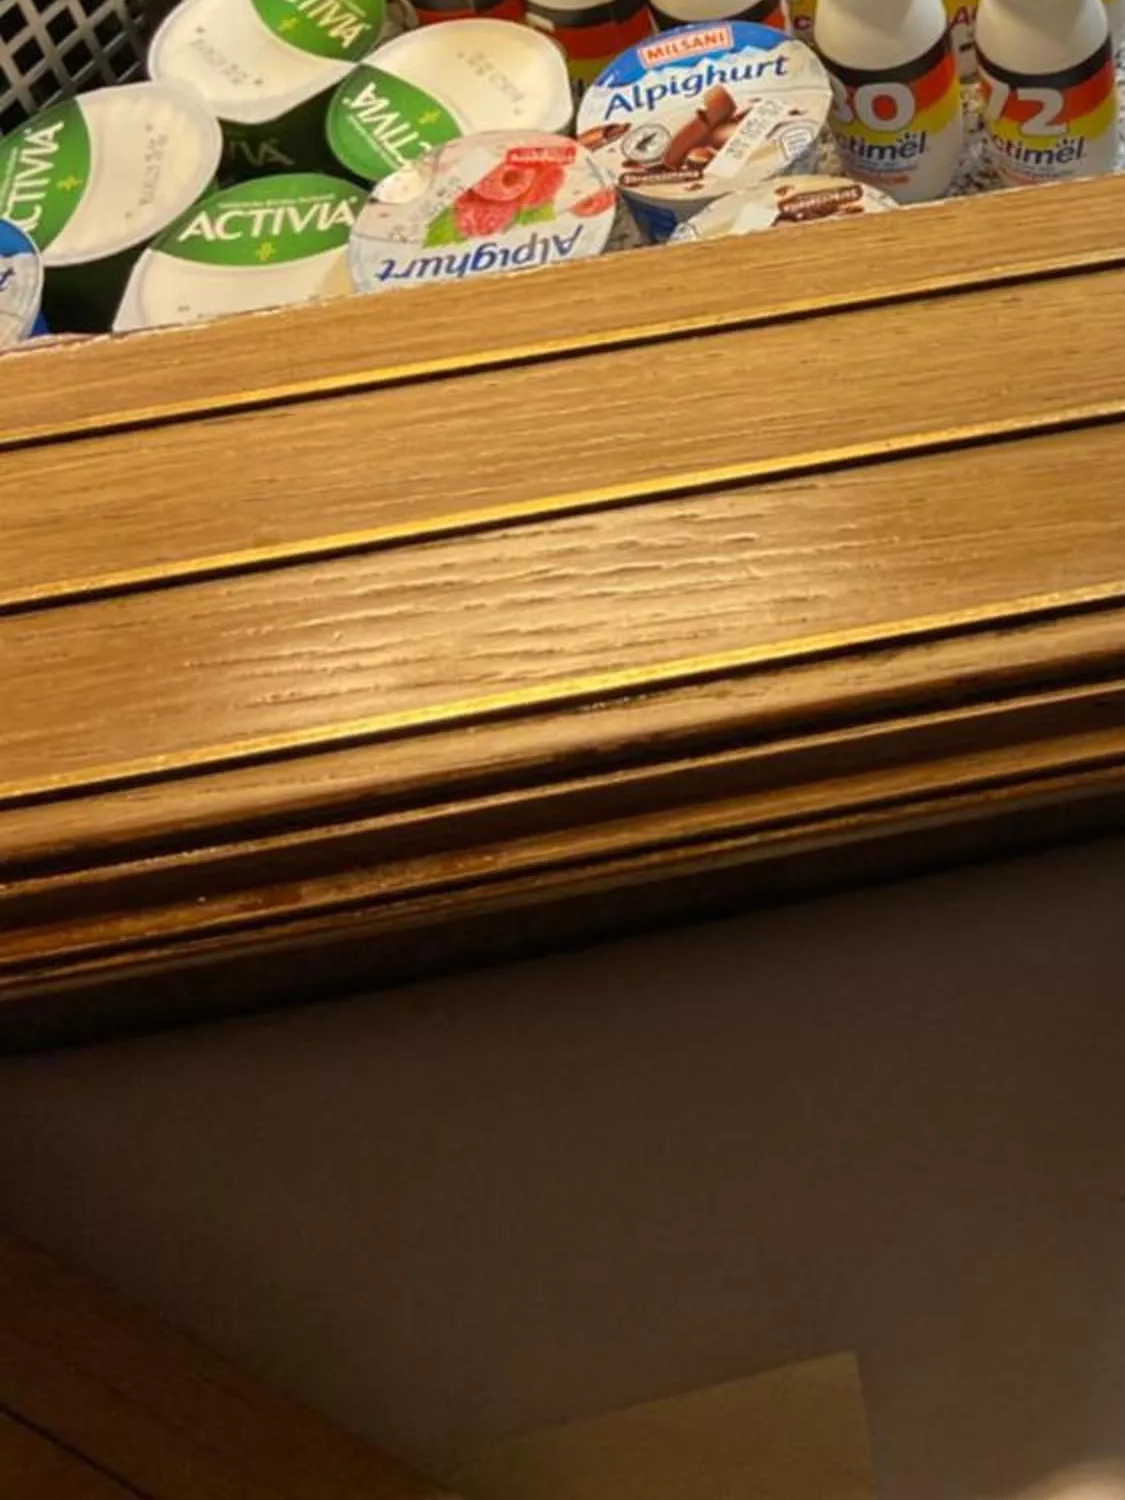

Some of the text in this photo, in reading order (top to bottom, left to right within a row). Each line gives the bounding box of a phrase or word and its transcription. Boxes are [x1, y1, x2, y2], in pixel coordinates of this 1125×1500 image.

[646, 30, 726, 61] MILSANI
[604, 54, 791, 120] Alpighurt
[4, 121, 65, 232] CTIVIA
[176, 199, 356, 242] ACTIVIA
[376, 224, 584, 281] Alpighurt
